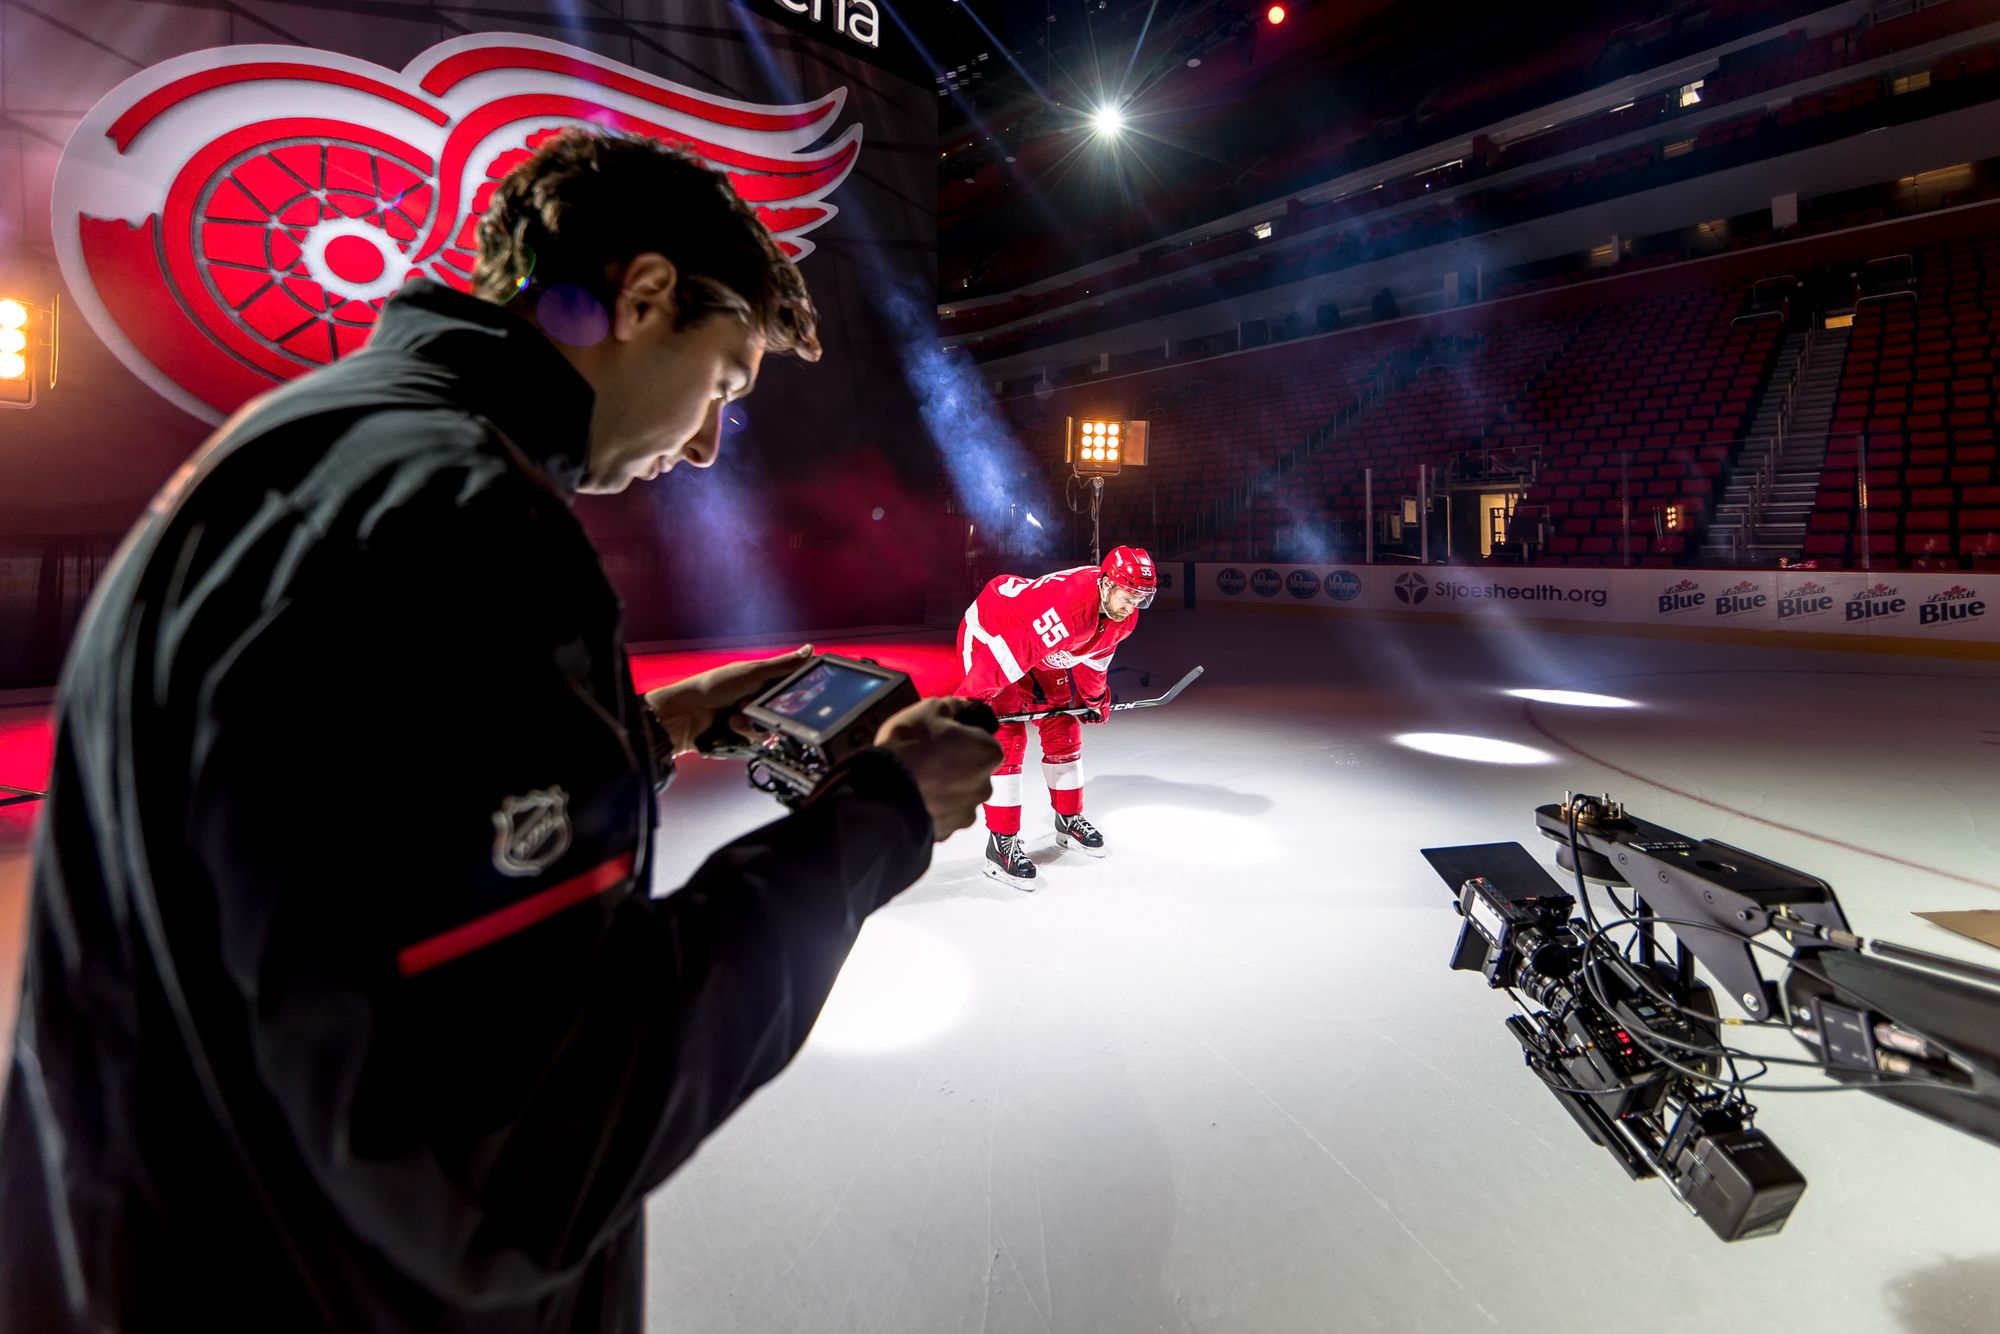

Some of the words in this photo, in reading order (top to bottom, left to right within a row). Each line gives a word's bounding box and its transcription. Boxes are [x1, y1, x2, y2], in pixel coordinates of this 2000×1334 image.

[1140, 567, 1152, 577] 55
[1328, 574, 1360, 592] Kroger
[1664, 583, 1699, 594] Labatt
[1721, 584, 1759, 596] Labatt
[1784, 586, 1826, 598] Labatt
[1435, 582, 1607, 607] Stjoeshealth.org
[1658, 592, 1706, 613] Blue
[1852, 588, 1897, 600] Labatt
[1926, 590, 1977, 603] Labatt
[1716, 594, 1767, 616] Blue
[1778, 596, 1833, 618] Blue
[1845, 598, 1906, 621] Blue
[1919, 601, 1985, 625] Blue
[1032, 607, 1070, 648] 55
